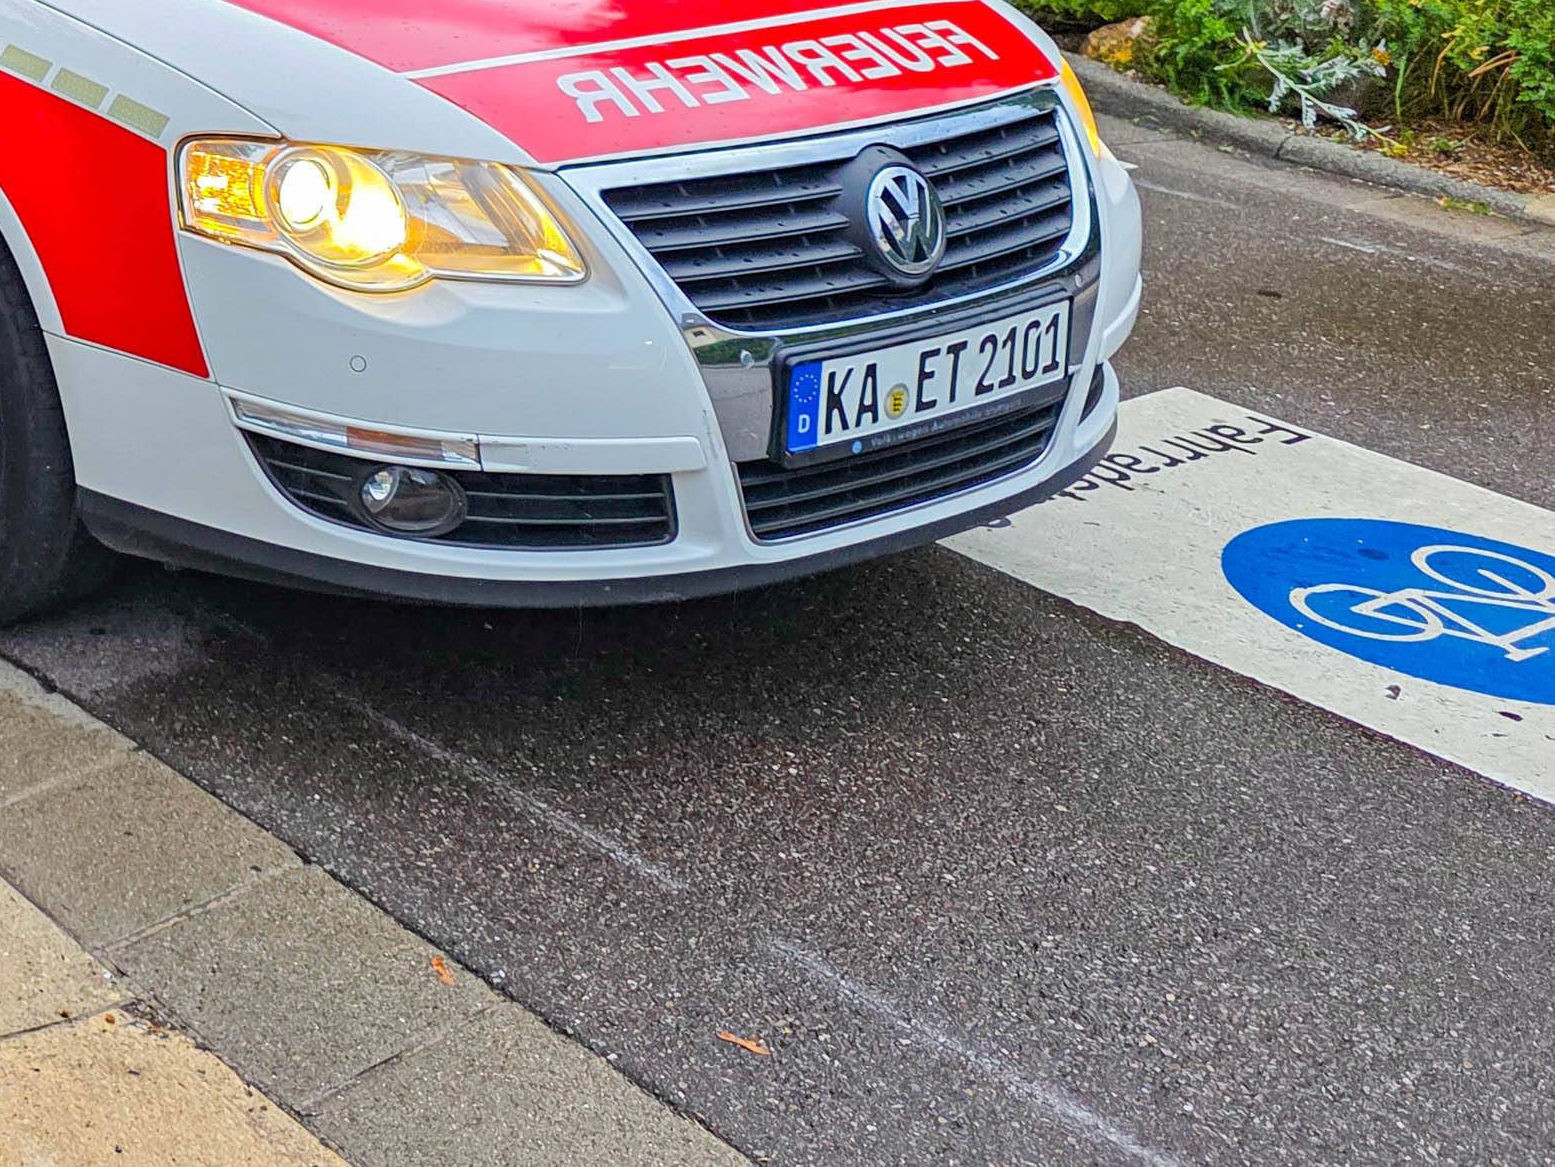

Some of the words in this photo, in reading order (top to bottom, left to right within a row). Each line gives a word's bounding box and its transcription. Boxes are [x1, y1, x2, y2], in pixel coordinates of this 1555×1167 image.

[825, 362, 880, 435] KA
[914, 340, 968, 413] ET
[974, 312, 1061, 397] 2101
[797, 413, 811, 434] D
